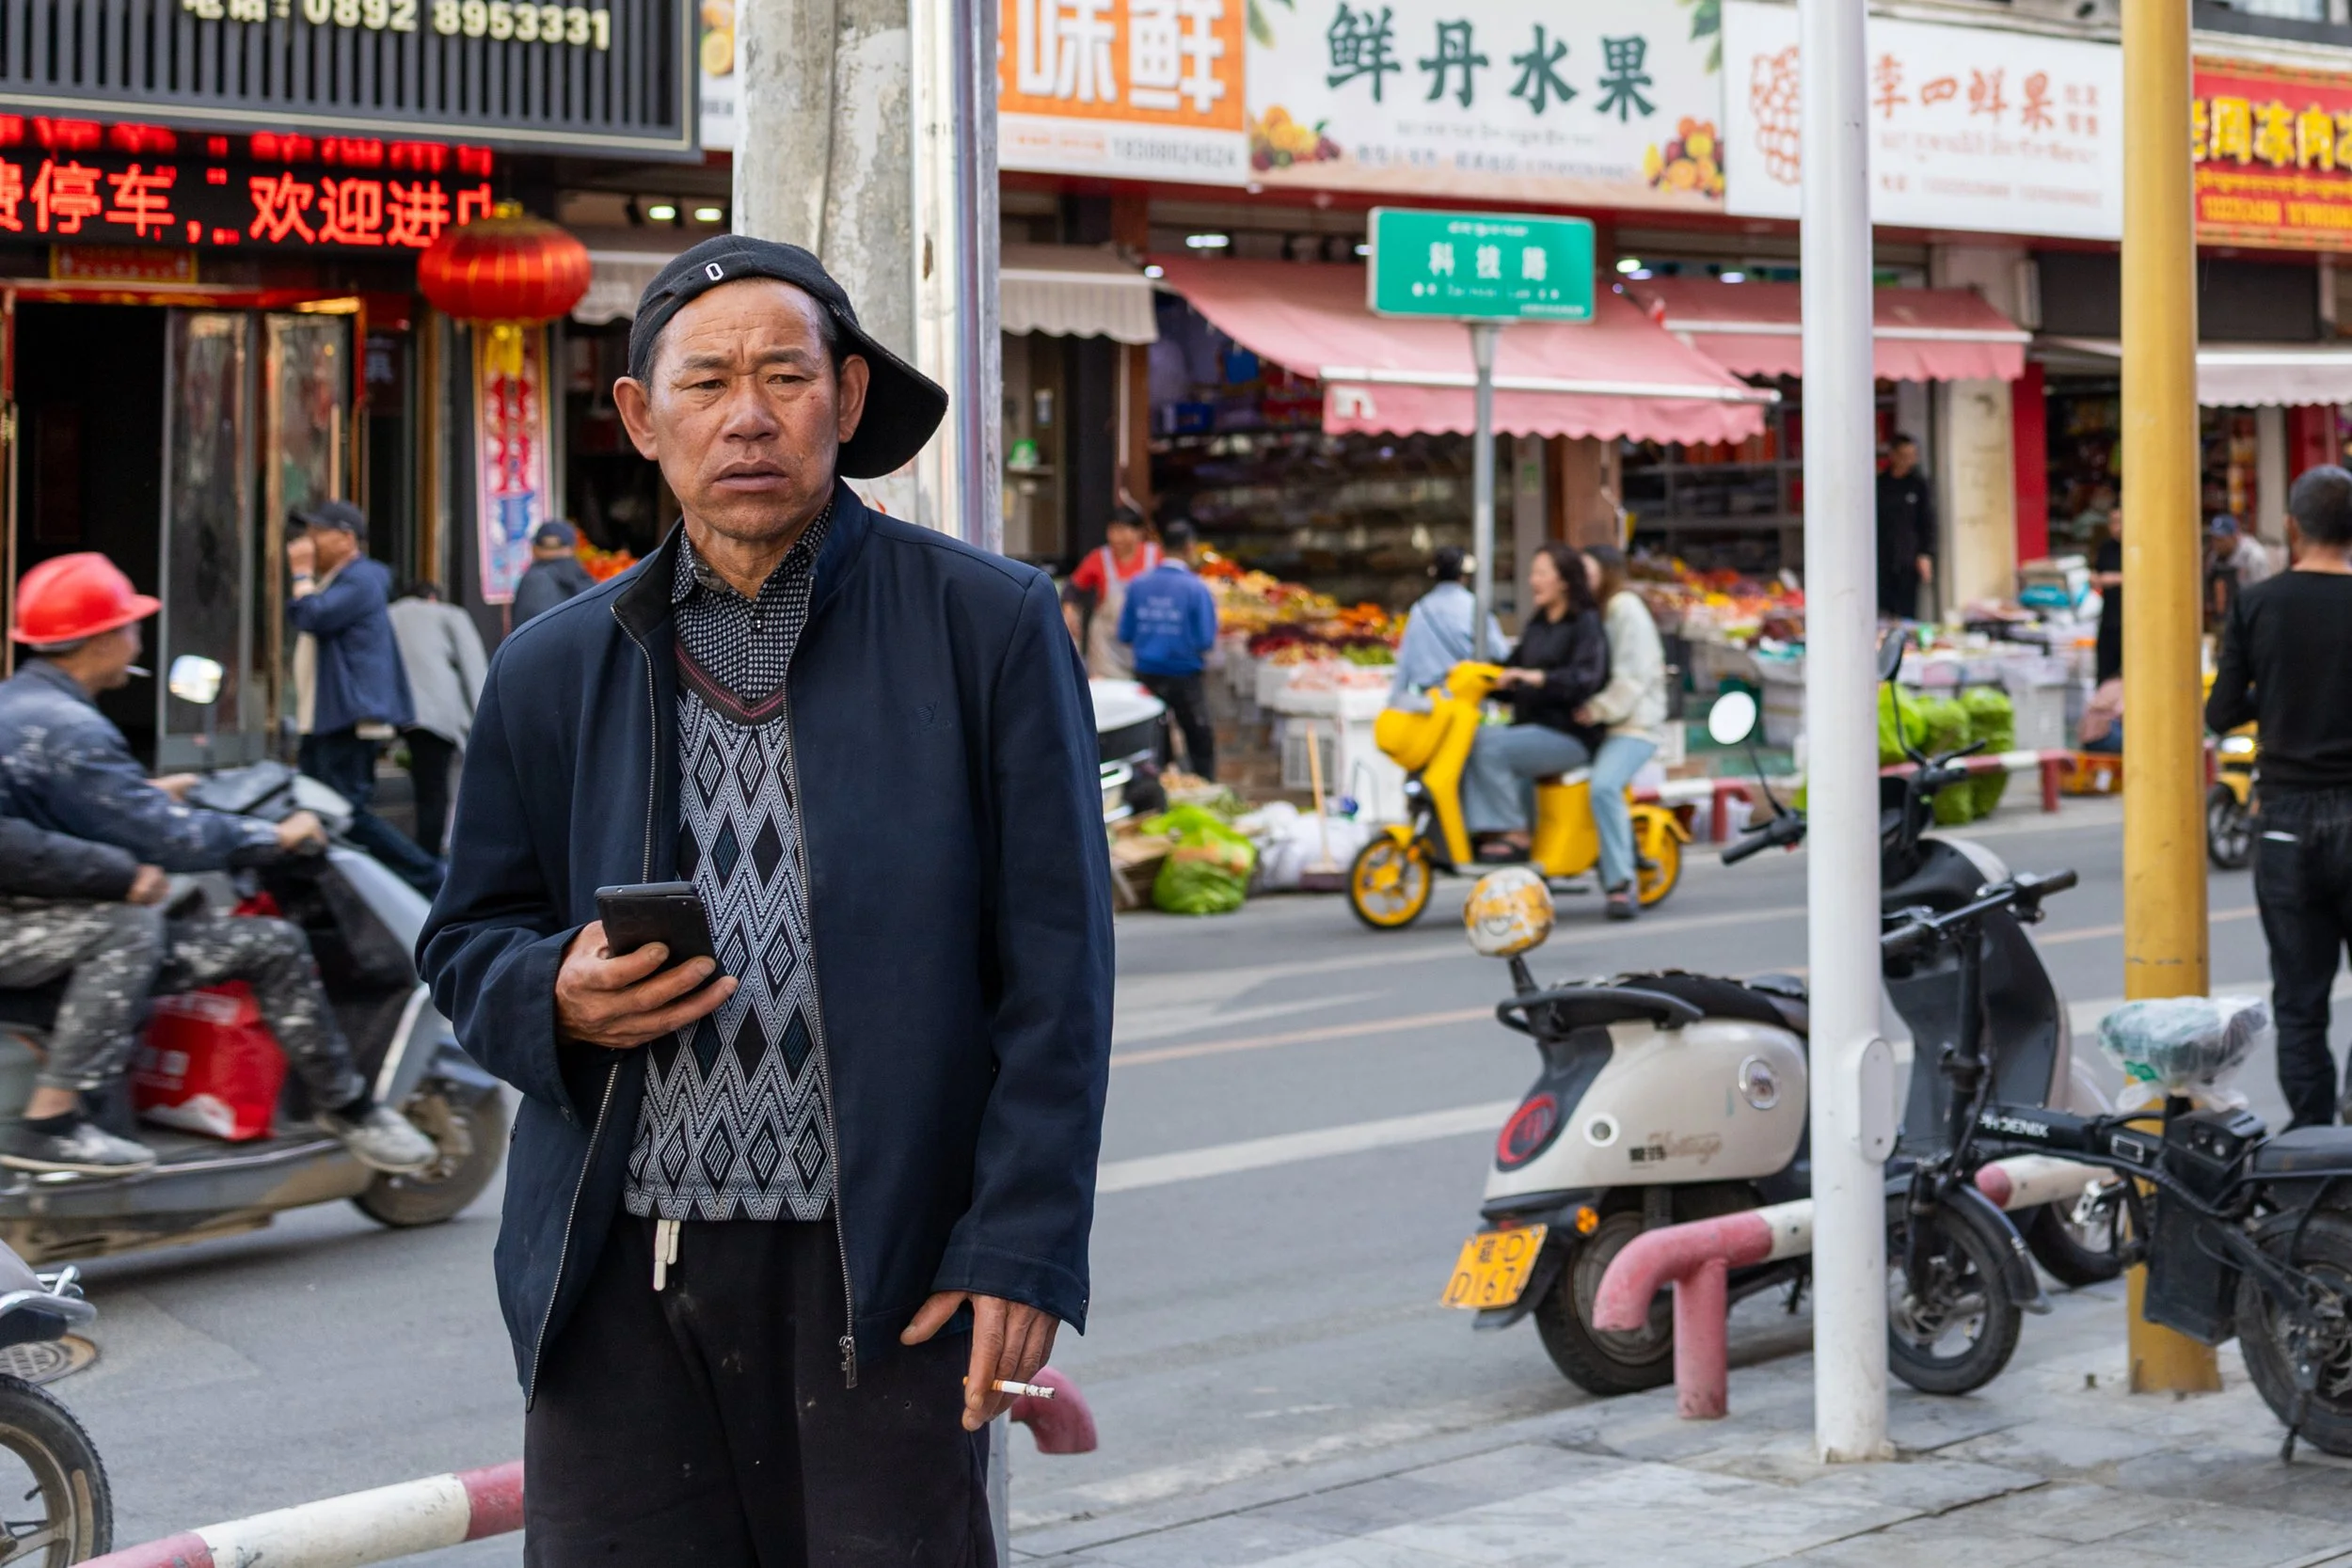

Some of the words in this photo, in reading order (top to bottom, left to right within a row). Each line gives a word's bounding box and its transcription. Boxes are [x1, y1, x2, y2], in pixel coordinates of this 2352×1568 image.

[303, 0, 418, 32] 0892
[433, 1, 611, 51] 8953331
[997, 0, 1226, 114] 味鲜
[1326, 2, 1656, 123] 鲜丹水果
